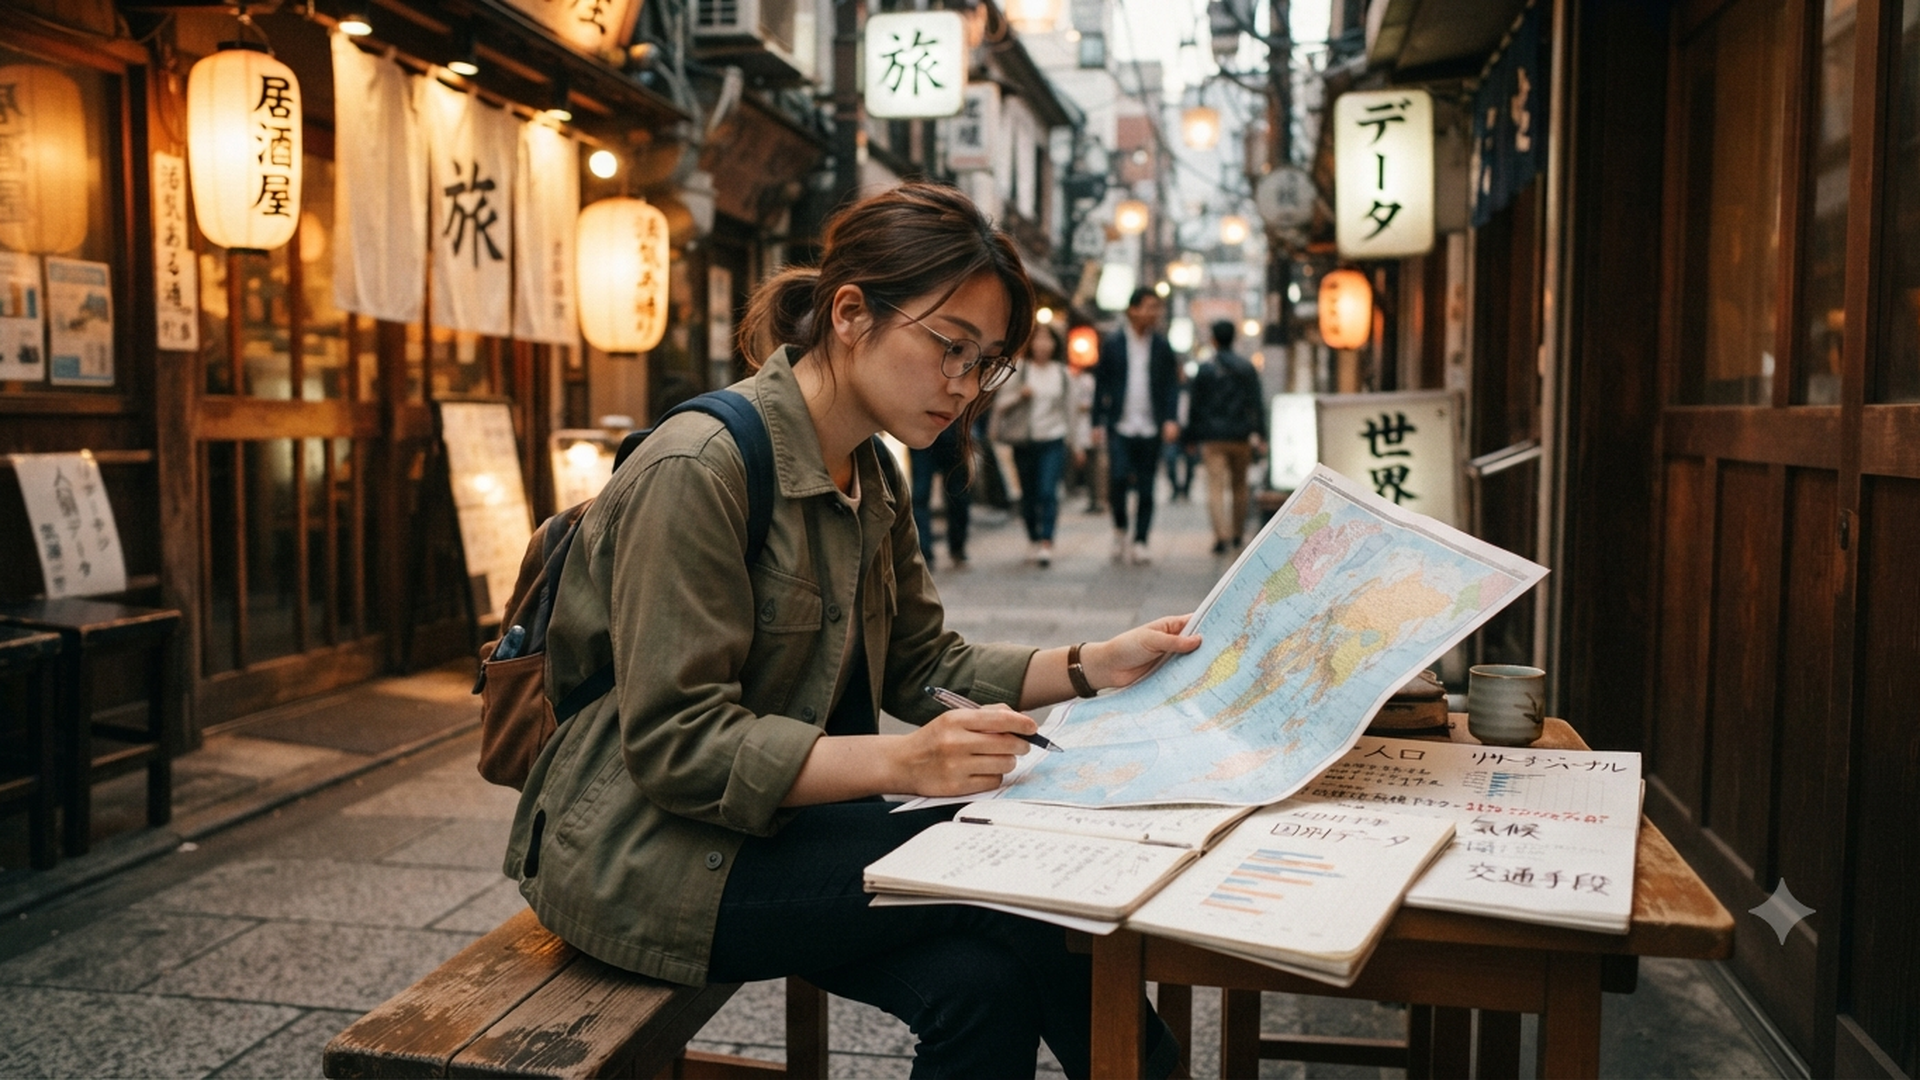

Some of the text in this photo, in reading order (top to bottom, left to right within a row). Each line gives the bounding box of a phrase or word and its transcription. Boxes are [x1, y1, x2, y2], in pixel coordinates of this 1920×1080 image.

[880, 30, 944, 96] 旅
[253, 74, 293, 218] 居酒屋
[1356, 98, 1413, 243] データ
[442, 160, 504, 271] 旅
[1360, 411, 1417, 505] 世界
[1364, 745, 1426, 760] 人口
[1465, 861, 1612, 897] 交通手段
